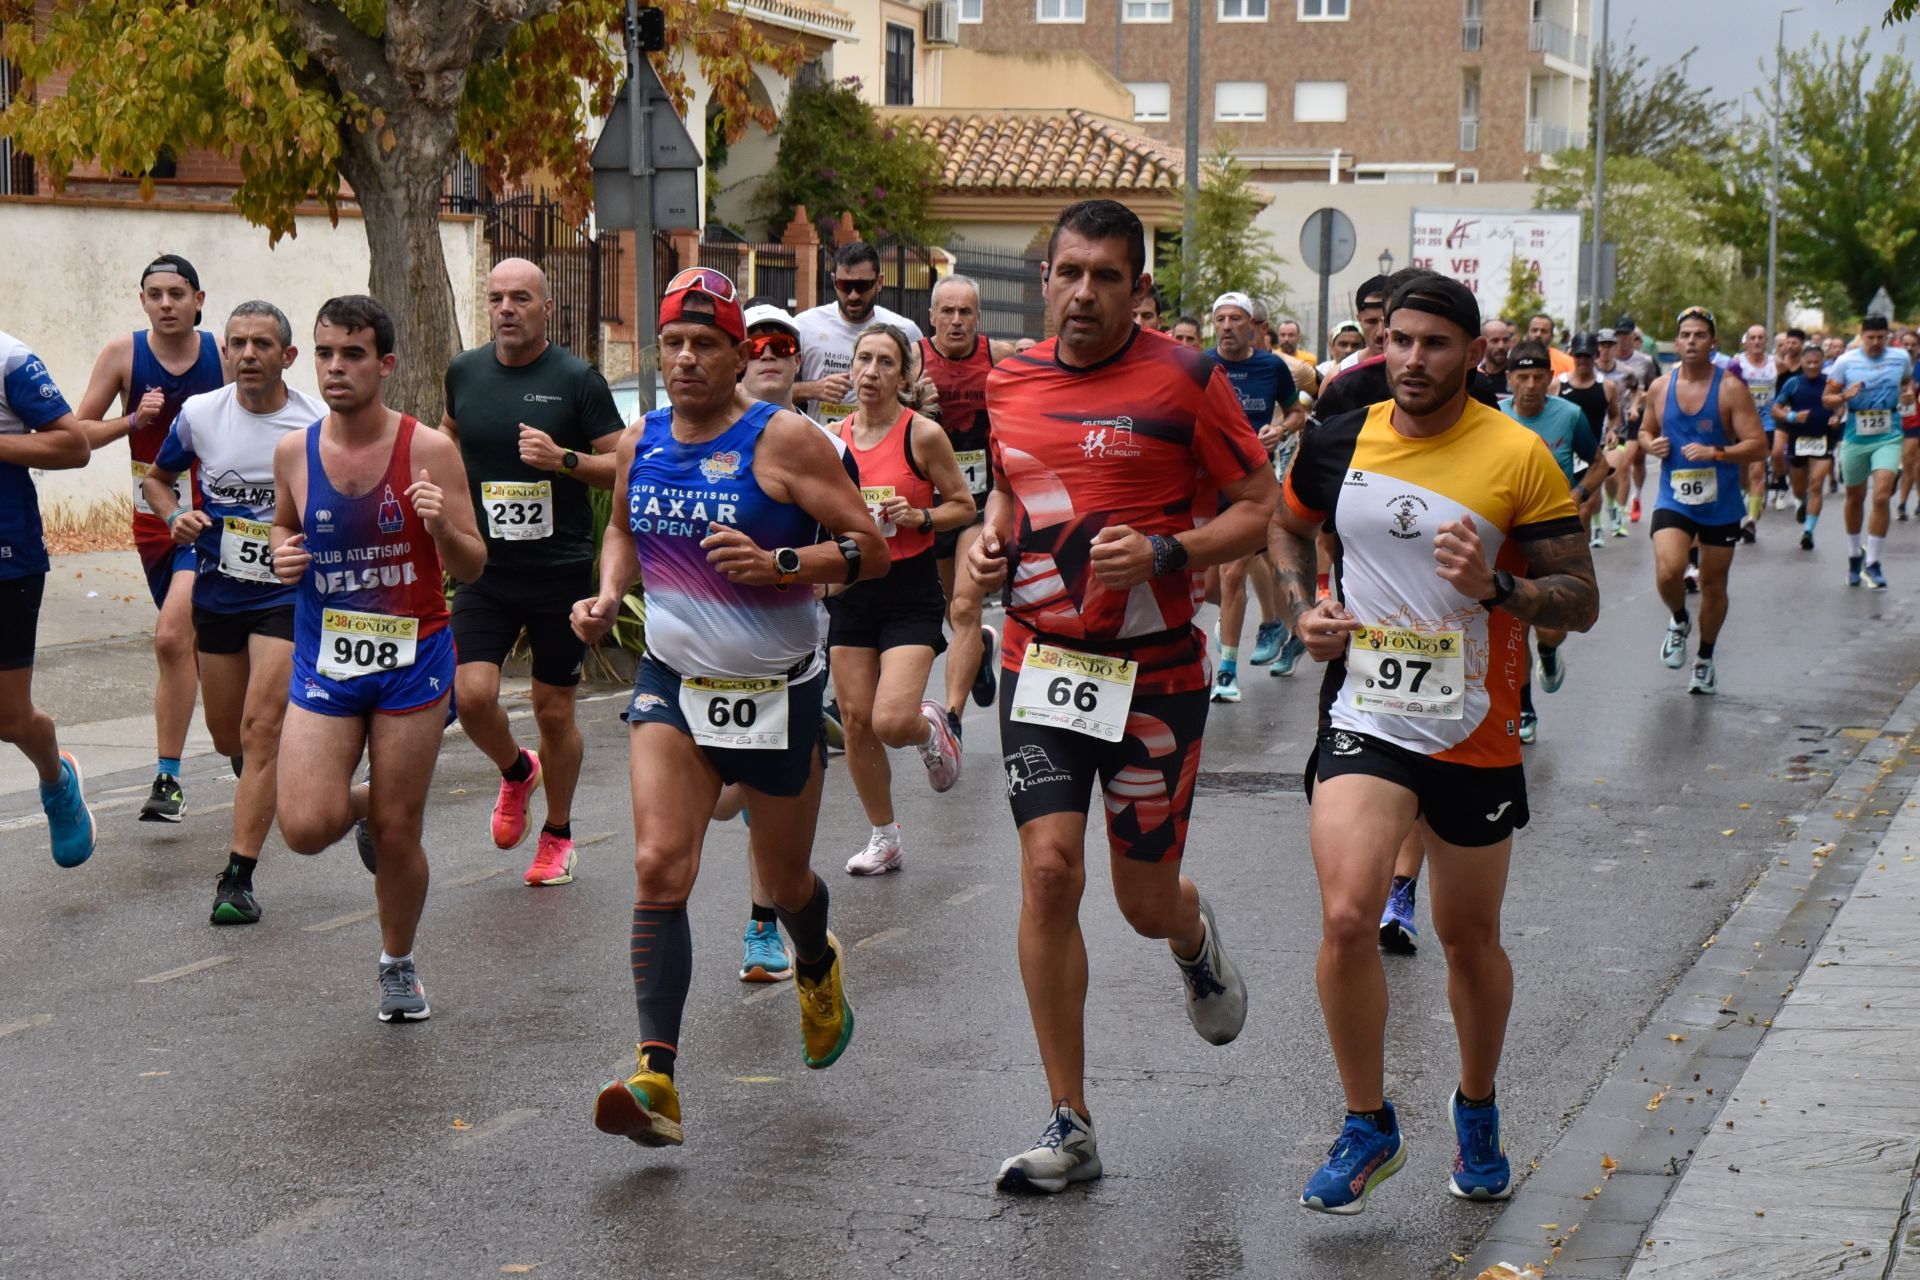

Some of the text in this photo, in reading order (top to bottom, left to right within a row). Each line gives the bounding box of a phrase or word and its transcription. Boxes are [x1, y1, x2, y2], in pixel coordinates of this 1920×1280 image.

[1861, 417, 1886, 429] 125
[1106, 449, 1142, 457] ALBOLOTE
[632, 484, 740, 502] CLUB ATLETISMO
[1681, 481, 1704, 496] 96
[492, 503, 543, 525] 232
[630, 494, 737, 524] CAXAR
[312, 542, 412, 565] CLUB ATLETISMO
[315, 561, 418, 595] DELSUR
[334, 614, 348, 628] 38
[347, 620, 397, 634] FONDO
[1387, 630, 1407, 638] GRAN
[333, 636, 399, 669] 908
[1383, 635, 1438, 654] FONDO
[1041, 650, 1059, 666] 38
[1057, 657, 1113, 677] FONDO
[1377, 657, 1432, 694] 97
[1047, 676, 1099, 713] 66
[707, 696, 757, 728] 60
[1027, 774, 1073, 787] ALBOLOTE
